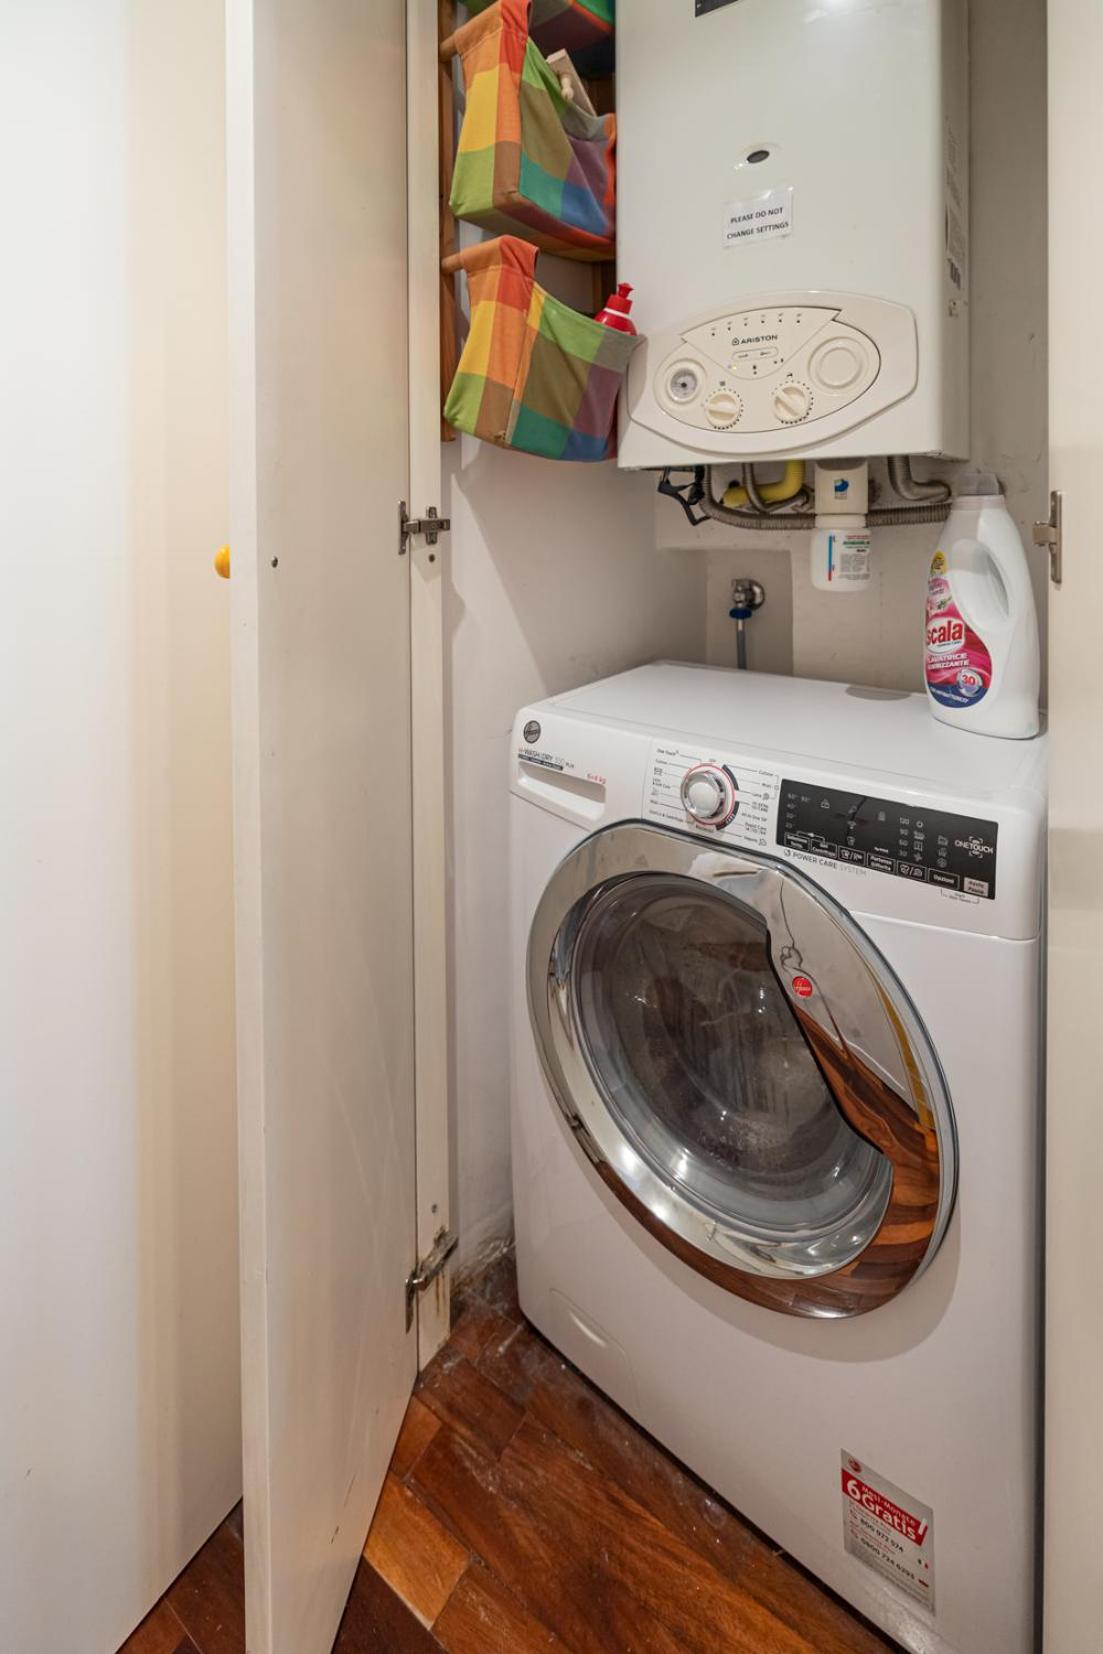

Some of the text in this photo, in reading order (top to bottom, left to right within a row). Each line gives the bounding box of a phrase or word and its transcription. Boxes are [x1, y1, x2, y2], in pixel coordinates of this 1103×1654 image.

[730, 206, 783, 224] PLEASE DO NOT
[726, 221, 789, 239] CHANGE SETTINGS
[740, 334, 778, 345] ARISTON
[927, 620, 963, 645] scala
[962, 674, 976, 686] 30
[847, 1480, 861, 1501] 6
[862, 1493, 917, 1540] Gratis
